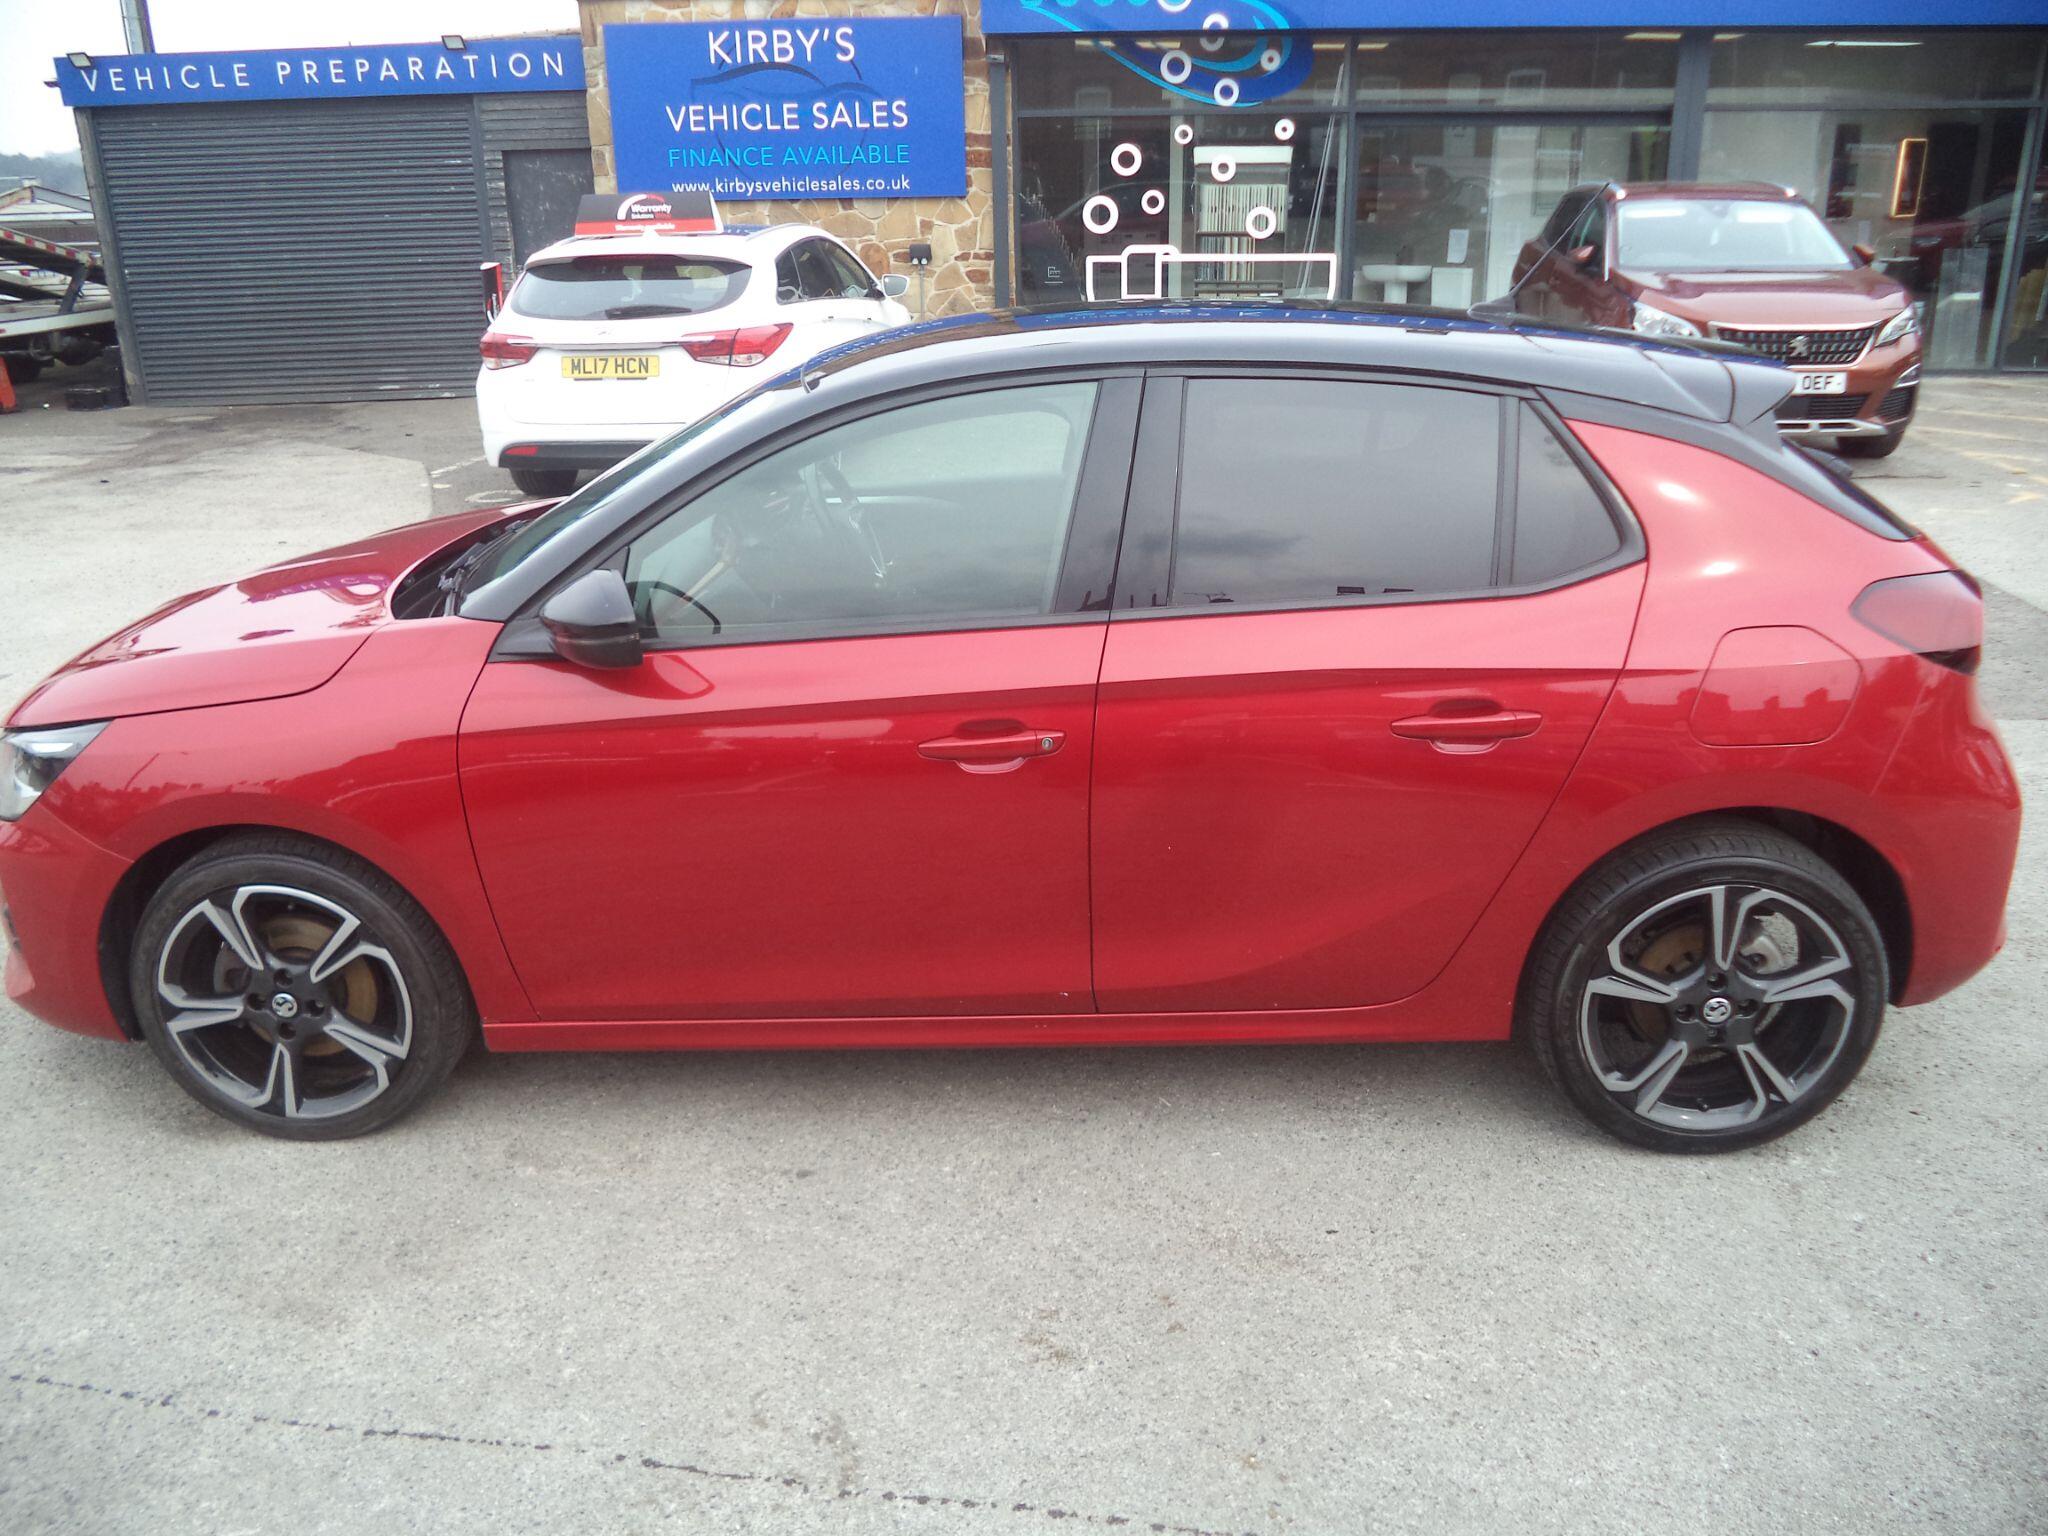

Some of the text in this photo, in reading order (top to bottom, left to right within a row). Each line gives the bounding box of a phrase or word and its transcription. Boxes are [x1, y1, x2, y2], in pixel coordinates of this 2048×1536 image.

[708, 27, 856, 64] KIRBY'S
[80, 52, 565, 92] VEHICLE PREPARATION
[665, 100, 909, 132] VEHICLE SALES
[669, 144, 911, 168] FINANCE AVAILABLE
[671, 174, 911, 197] www.kirbysvehiclesales.co.uk
[571, 357, 649, 375] ML17 HCN
[1802, 375, 1834, 390] OEF
